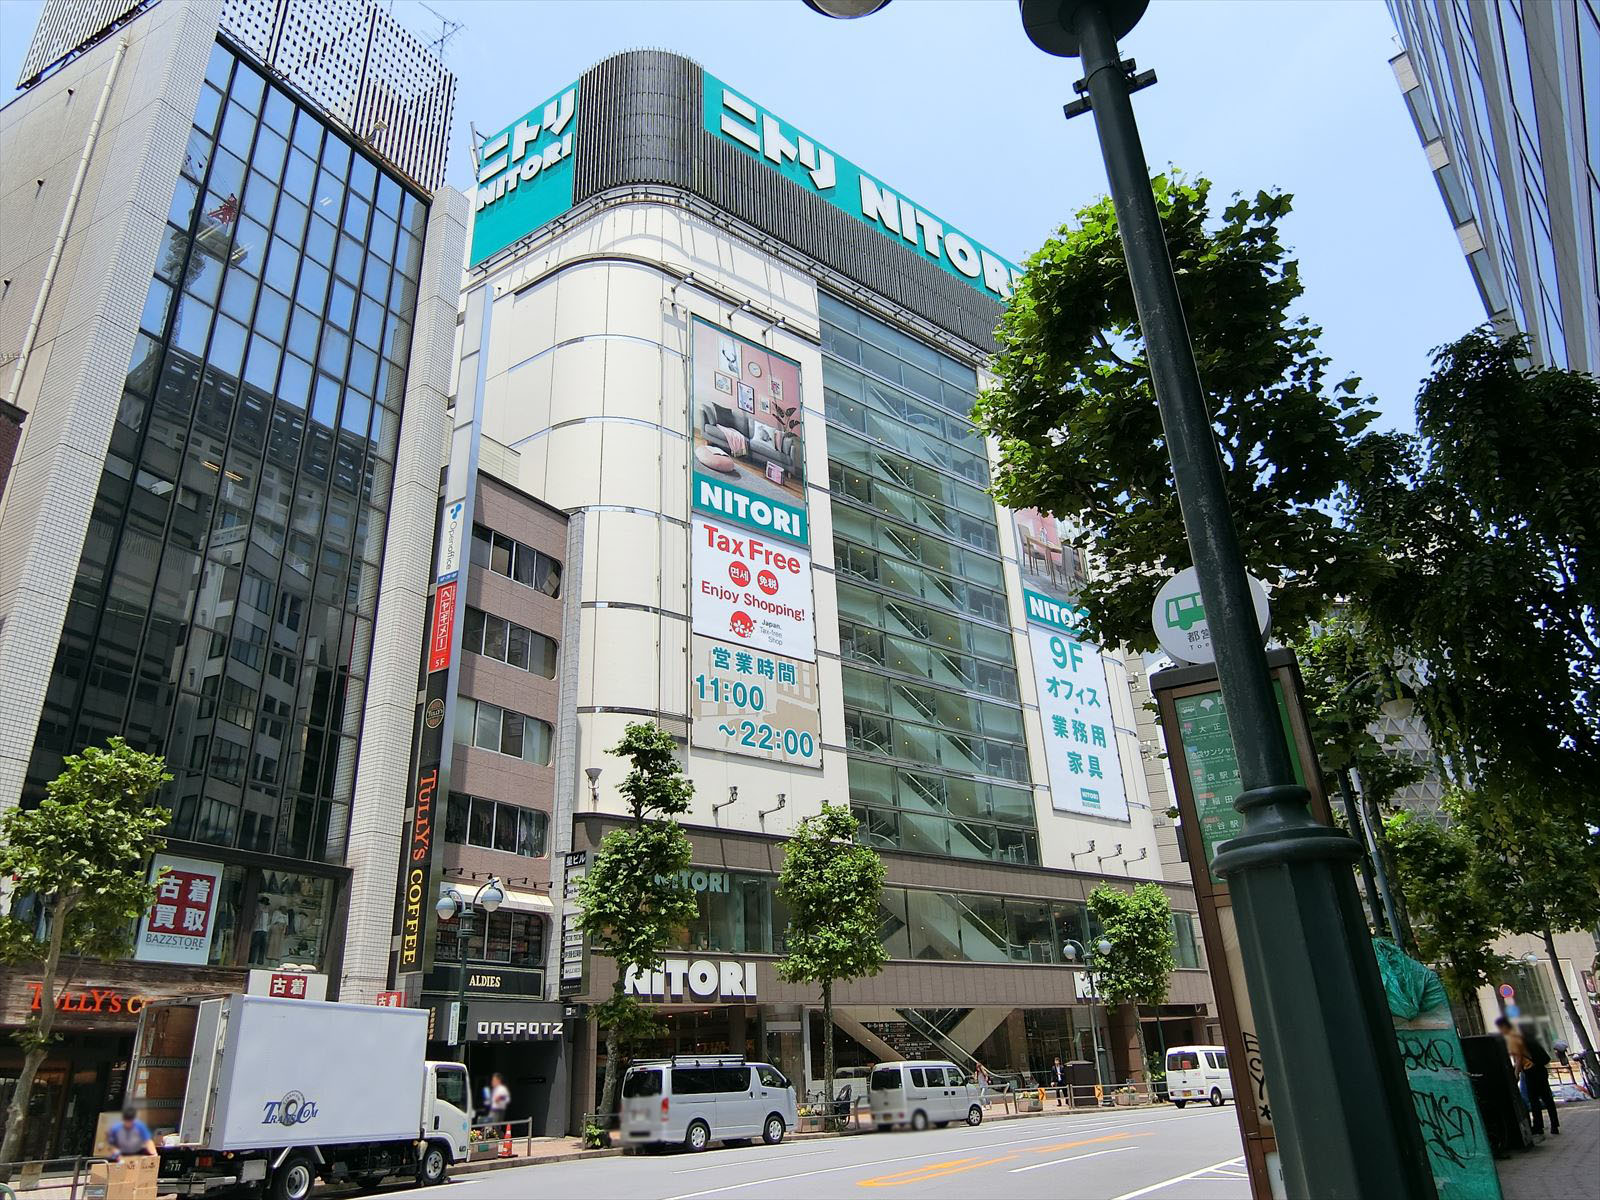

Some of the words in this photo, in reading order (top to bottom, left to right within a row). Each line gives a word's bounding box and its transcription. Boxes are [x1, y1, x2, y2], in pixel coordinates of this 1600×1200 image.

[479, 88, 576, 184] ニトリ
[720, 88, 836, 190] ニトリ
[475, 132, 573, 212] NITORI
[700, 480, 800, 538] NITORI
[703, 523, 745, 558] Tax
[748, 539, 801, 575] Free
[701, 579, 740, 603] Enjoy
[743, 593, 805, 622] Shopping!
[435, 657, 445, 667] 5F
[712, 646, 796, 686] 営業時間
[1049, 636, 1083, 673] 9F
[695, 673, 764, 712] 11:00
[1045, 676, 1101, 708] オフィス
[1051, 714, 1107, 749] 業務用
[1067, 750, 1103, 780] 家具
[412, 769, 437, 861] TULLY'S
[158, 874, 211, 903] 古着
[152, 903, 207, 932] 買取
[403, 868, 423, 965] COFFEE
[145, 933, 205, 949] BAZZSTORE
[273, 977, 305, 995] 古着
[468, 975, 501, 988] ALDIES
[624, 959, 757, 996] NITORI
